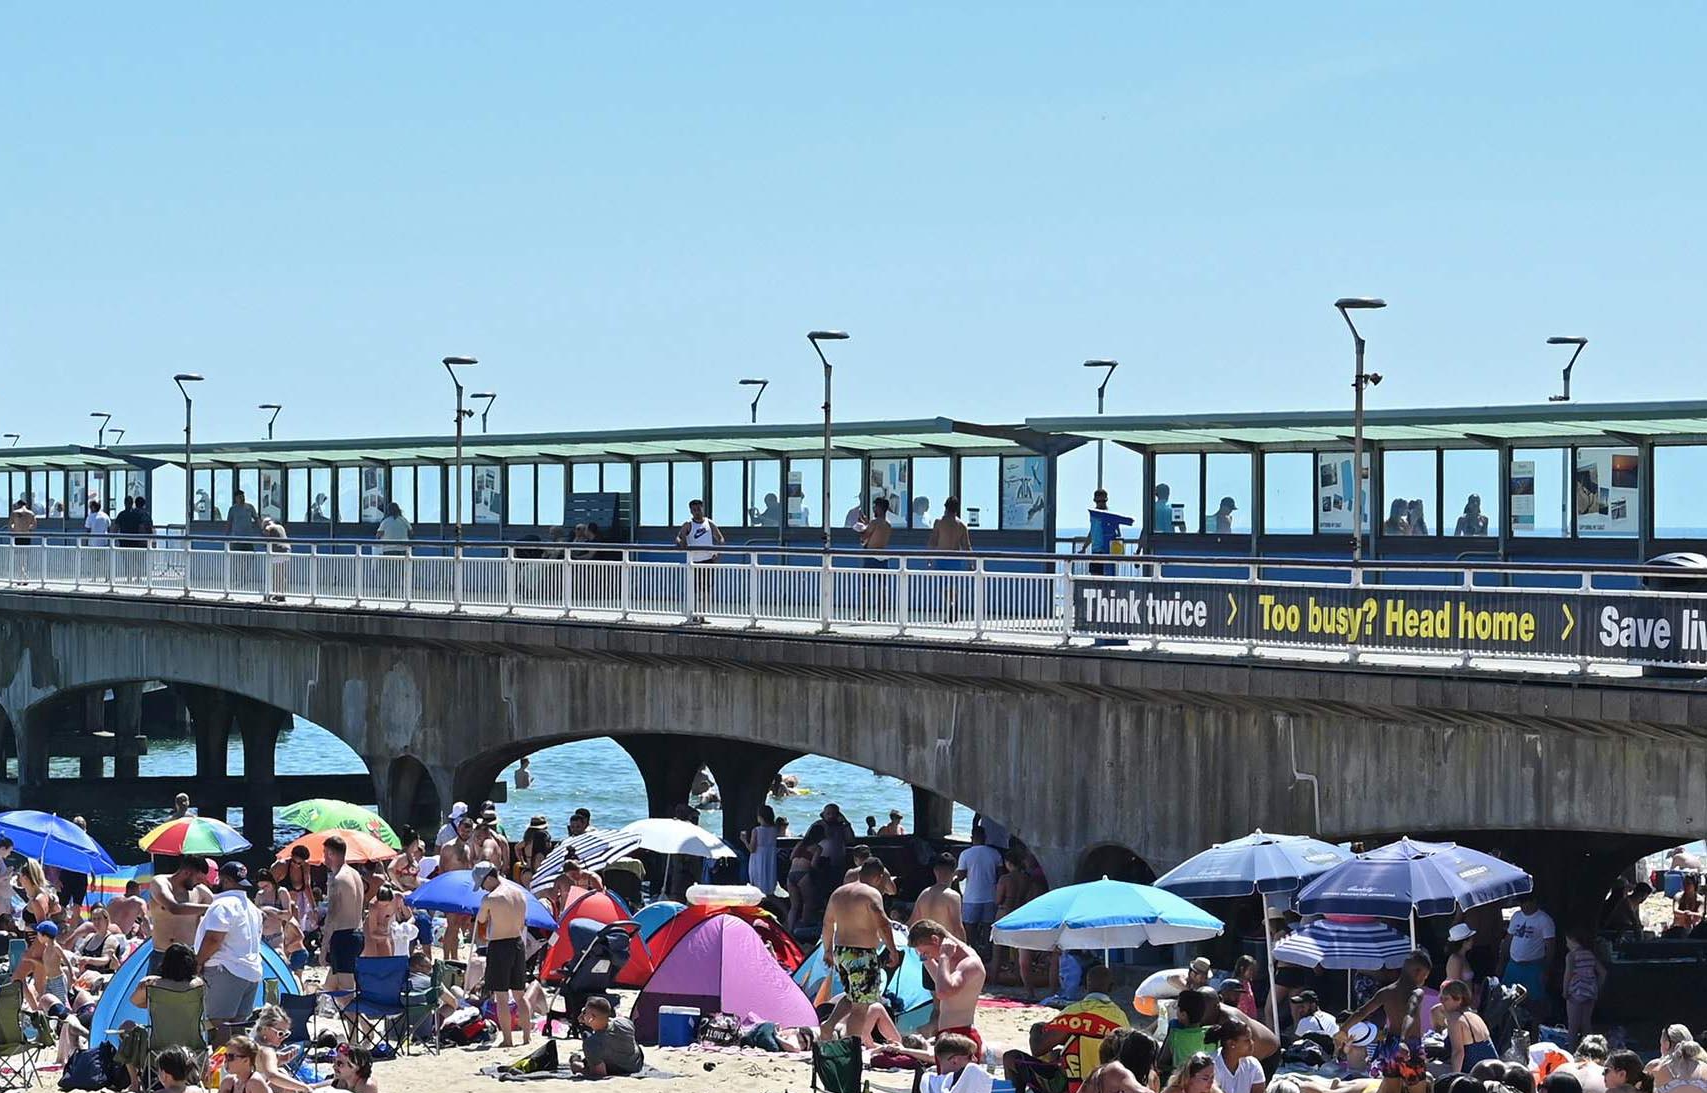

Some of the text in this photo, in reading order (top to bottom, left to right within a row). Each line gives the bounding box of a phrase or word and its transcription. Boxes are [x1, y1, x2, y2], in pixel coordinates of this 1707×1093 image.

[1083, 589, 1207, 627] Think twice
[1259, 594, 1535, 642] Too busy? Head home
[1599, 605, 1671, 648] Save
